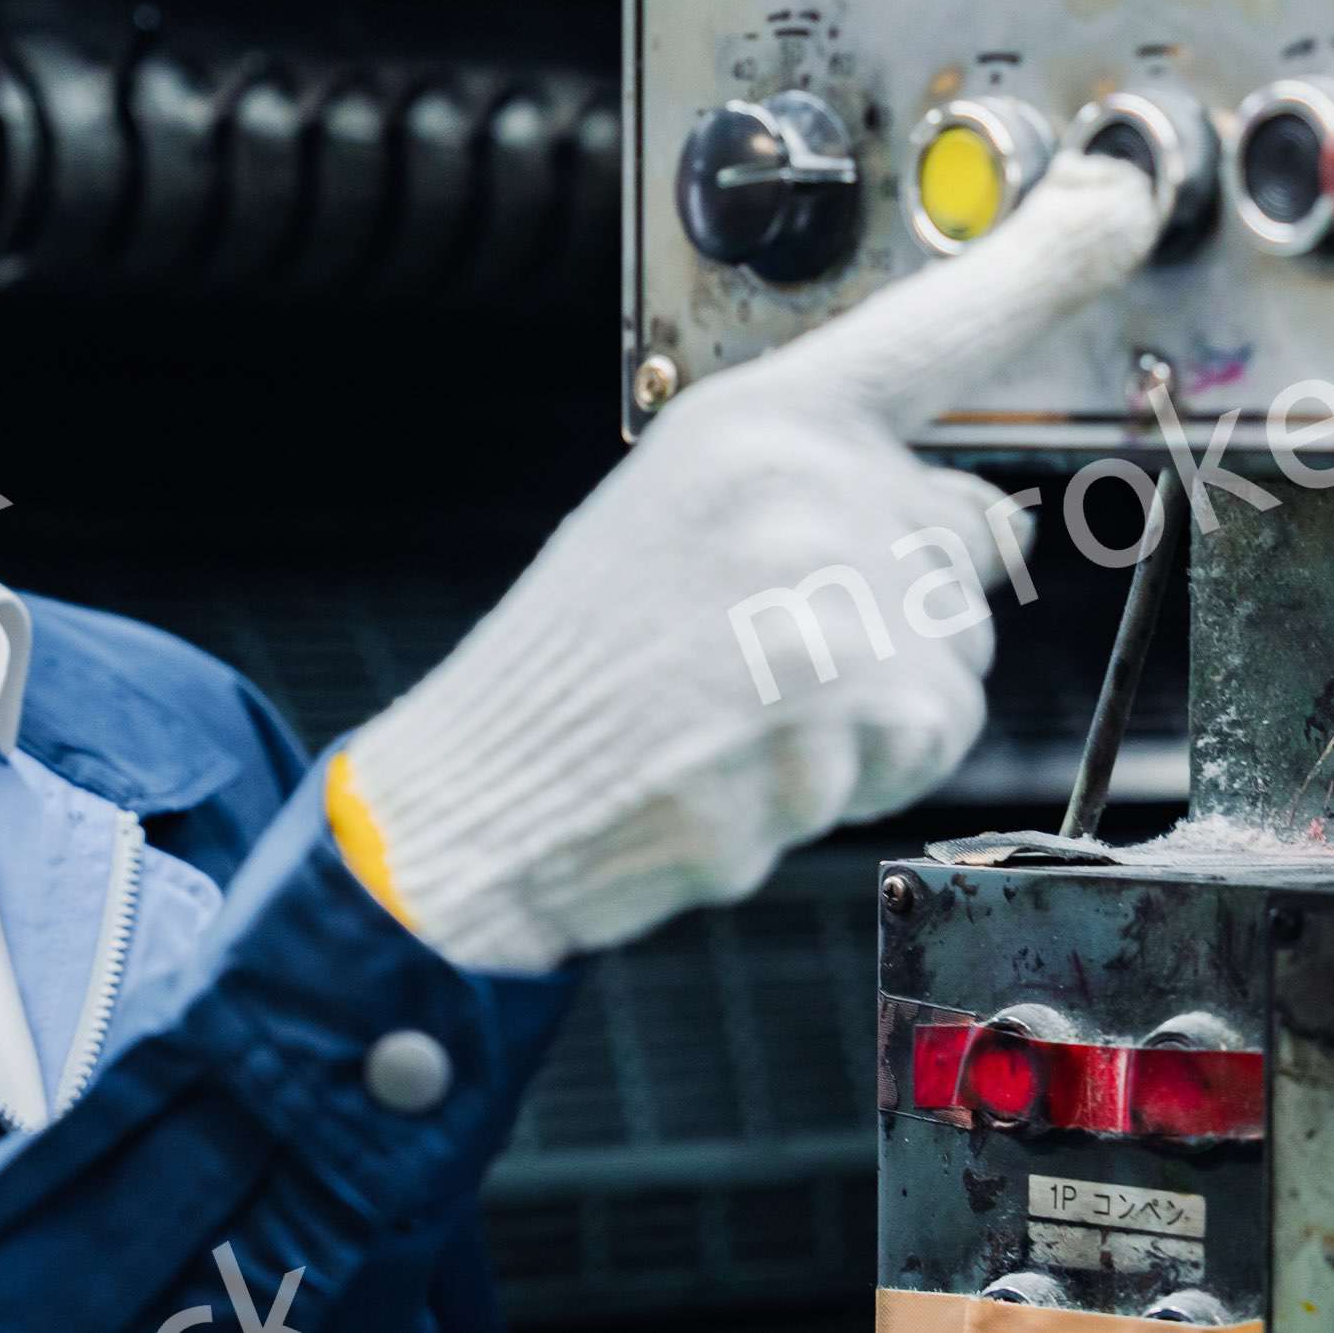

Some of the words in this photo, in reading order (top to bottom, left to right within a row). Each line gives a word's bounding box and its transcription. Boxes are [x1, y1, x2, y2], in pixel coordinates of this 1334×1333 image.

[1050, 1183, 1077, 1211] 1P
[1092, 1192, 1185, 1226] コンペン
